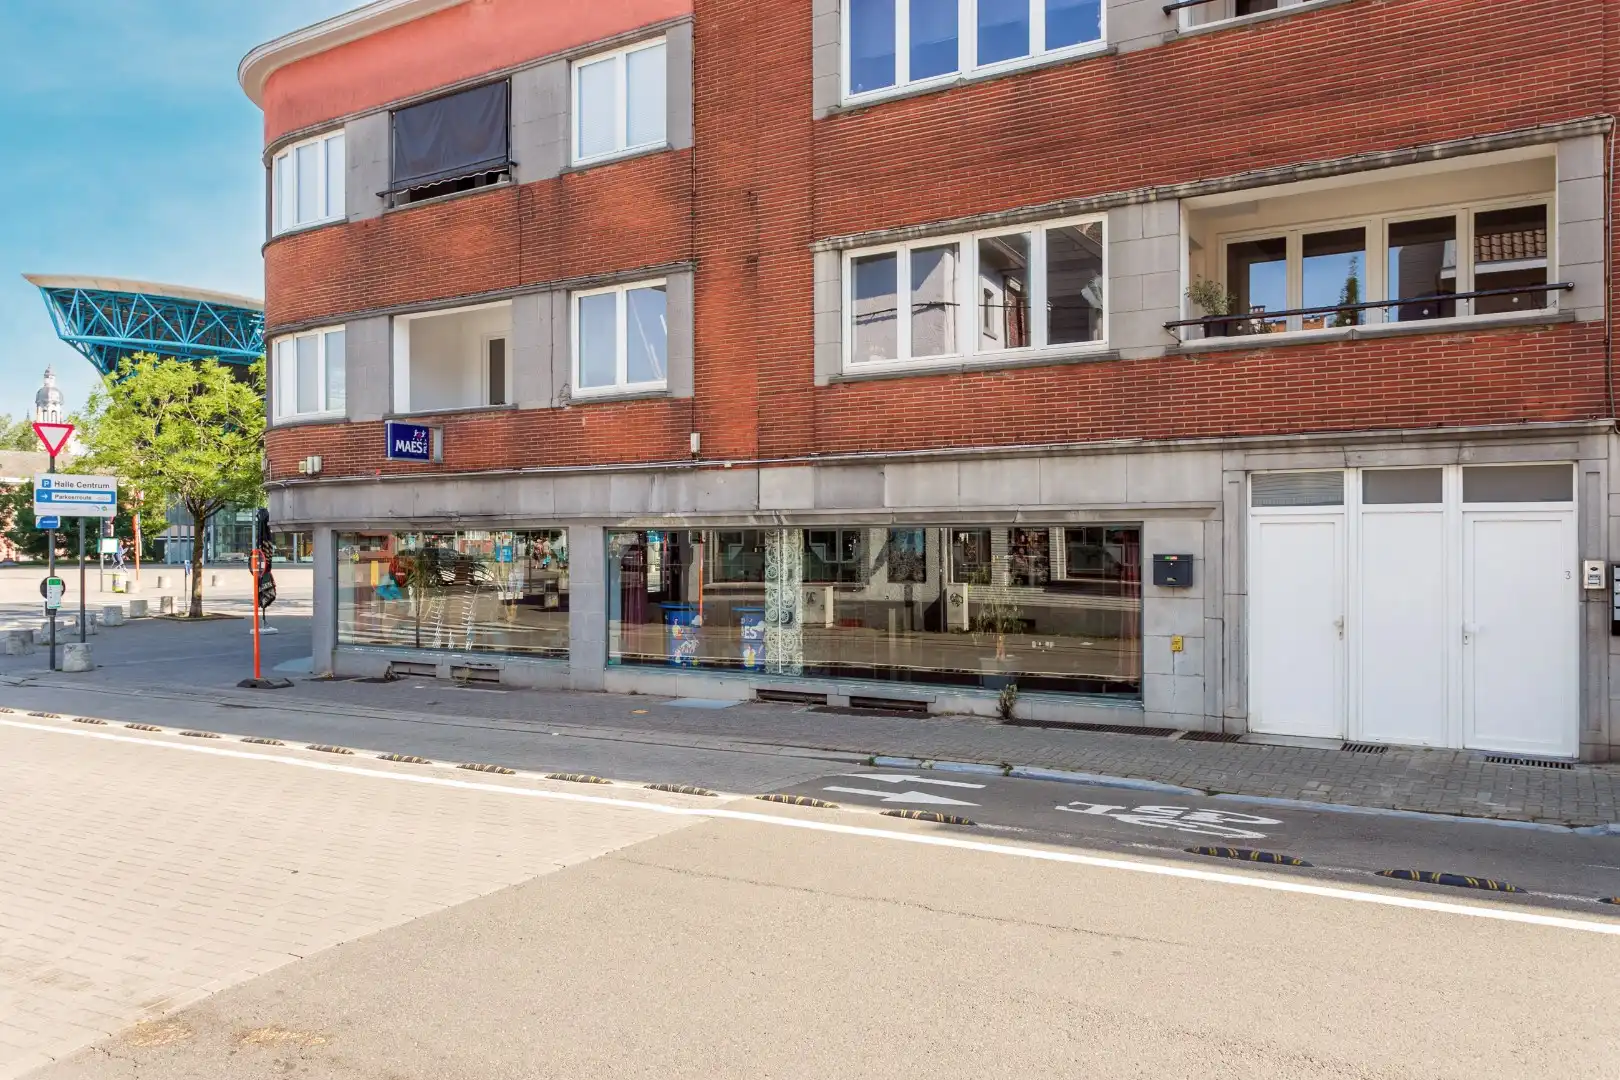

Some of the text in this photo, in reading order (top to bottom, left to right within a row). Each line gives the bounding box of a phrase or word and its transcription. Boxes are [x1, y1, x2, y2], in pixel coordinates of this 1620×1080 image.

[395, 439, 422, 454] MAES
[54, 480, 74, 488] Halle
[76, 481, 110, 489] Centrum
[1564, 570, 1571, 580] 3
